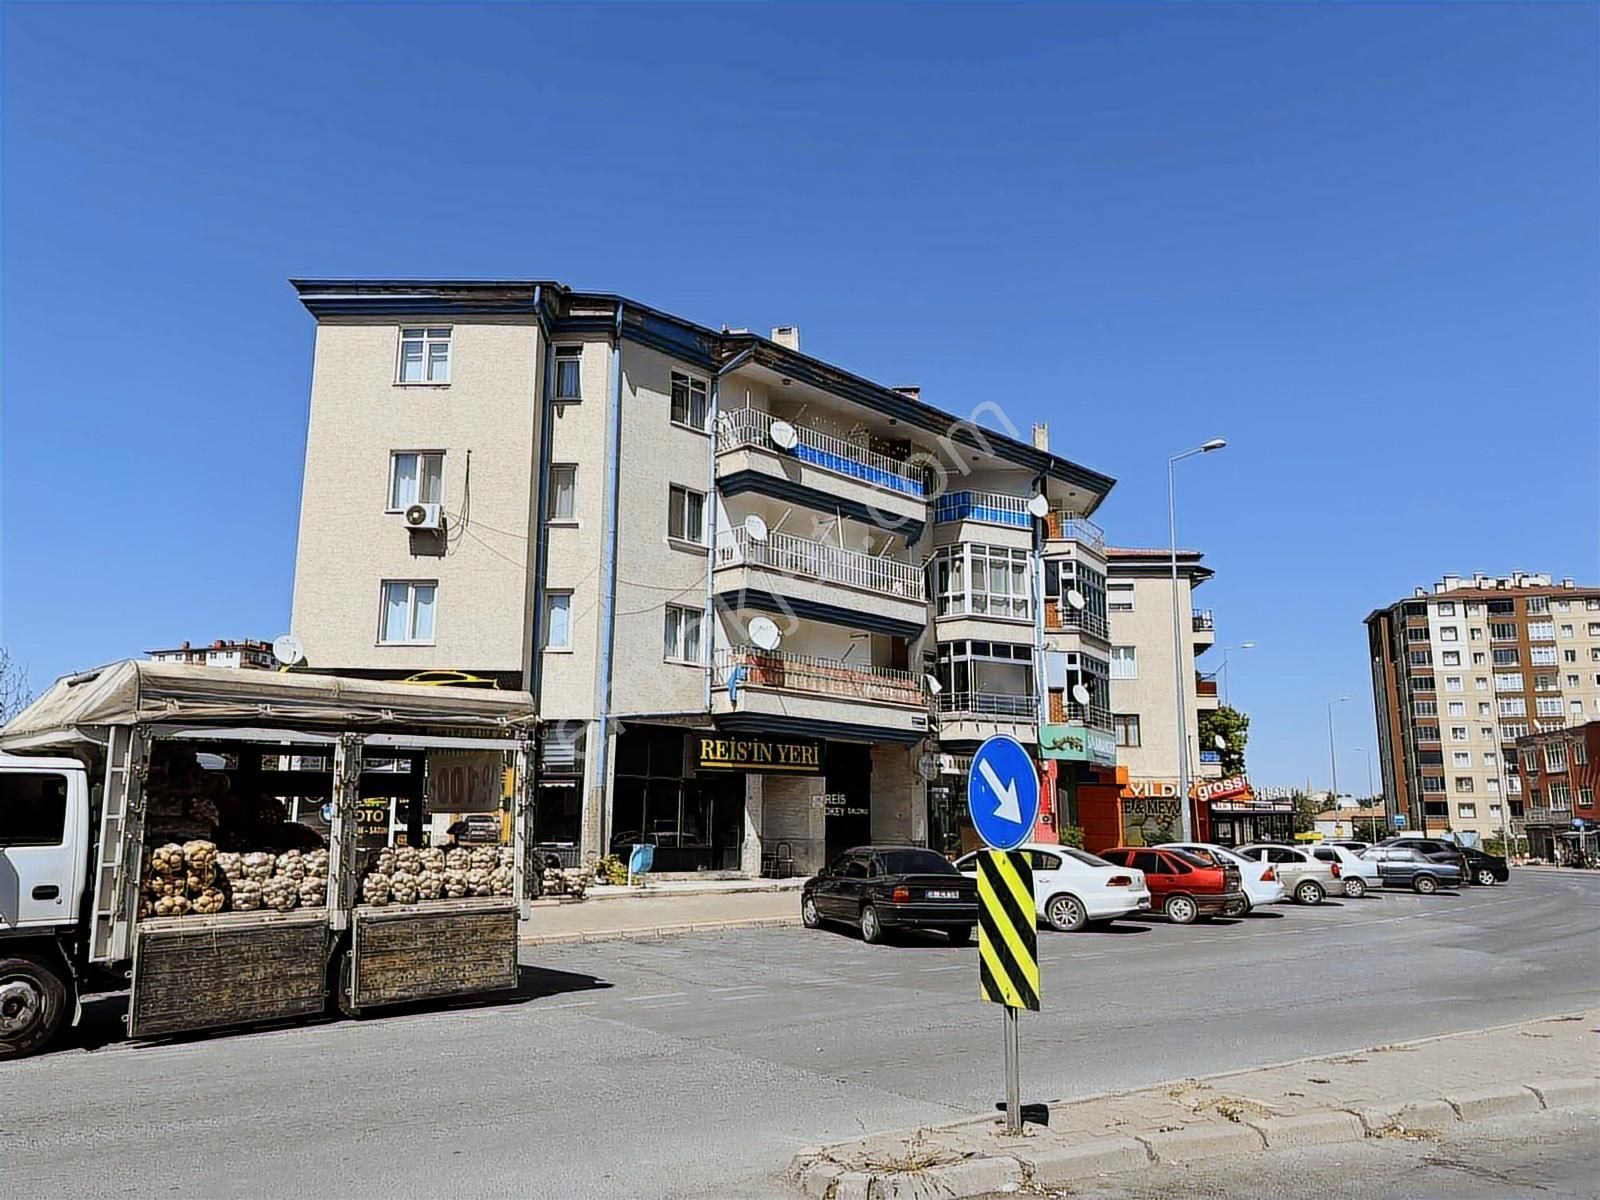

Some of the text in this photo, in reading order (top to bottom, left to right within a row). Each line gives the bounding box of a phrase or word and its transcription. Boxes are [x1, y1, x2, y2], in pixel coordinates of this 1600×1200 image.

[700, 736, 820, 765] REİS'İN YERİ
[1130, 783, 1193, 798] YILDI
[1146, 799, 1182, 814] MEYV
